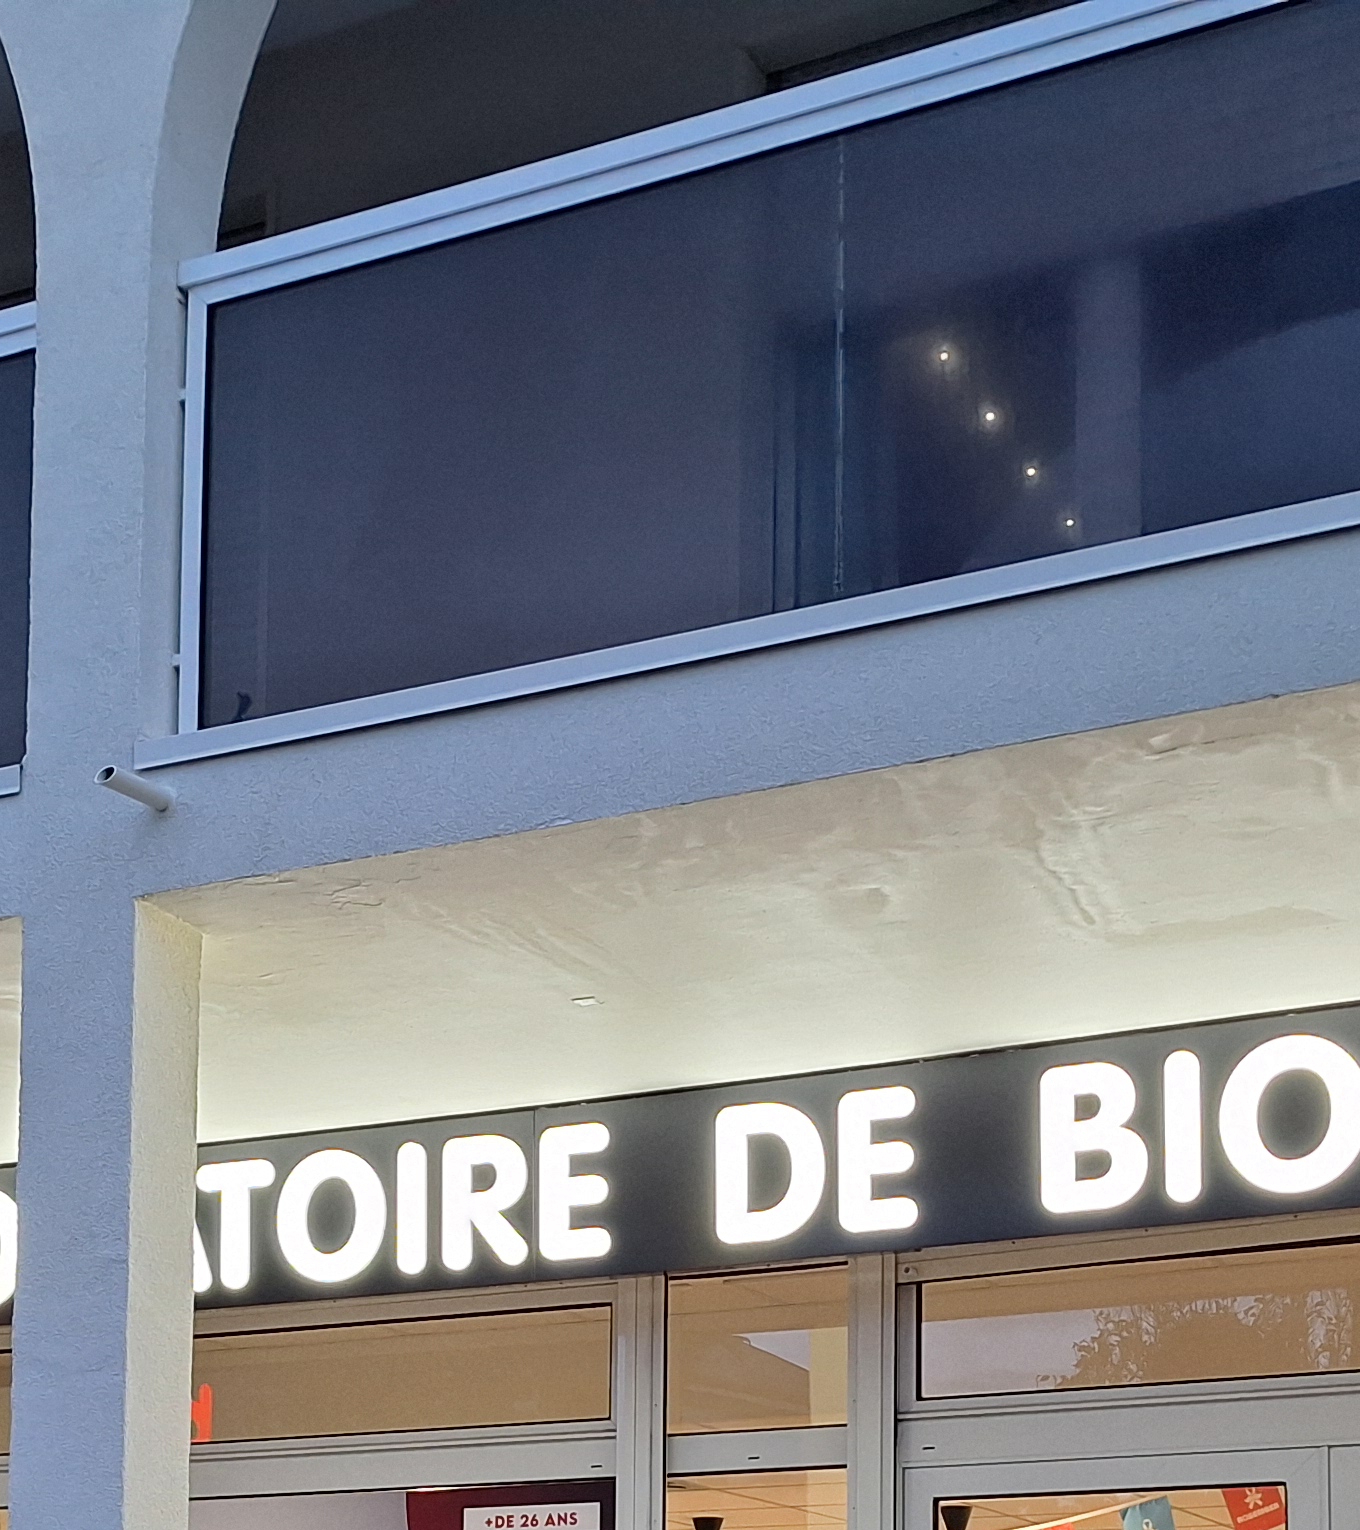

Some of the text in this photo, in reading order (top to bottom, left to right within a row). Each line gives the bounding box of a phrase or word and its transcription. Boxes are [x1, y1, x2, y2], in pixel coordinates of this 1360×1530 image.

[713, 1084, 921, 1246] DE
[520, 1513, 539, 1528] 26
[544, 1512, 578, 1527] ANS
